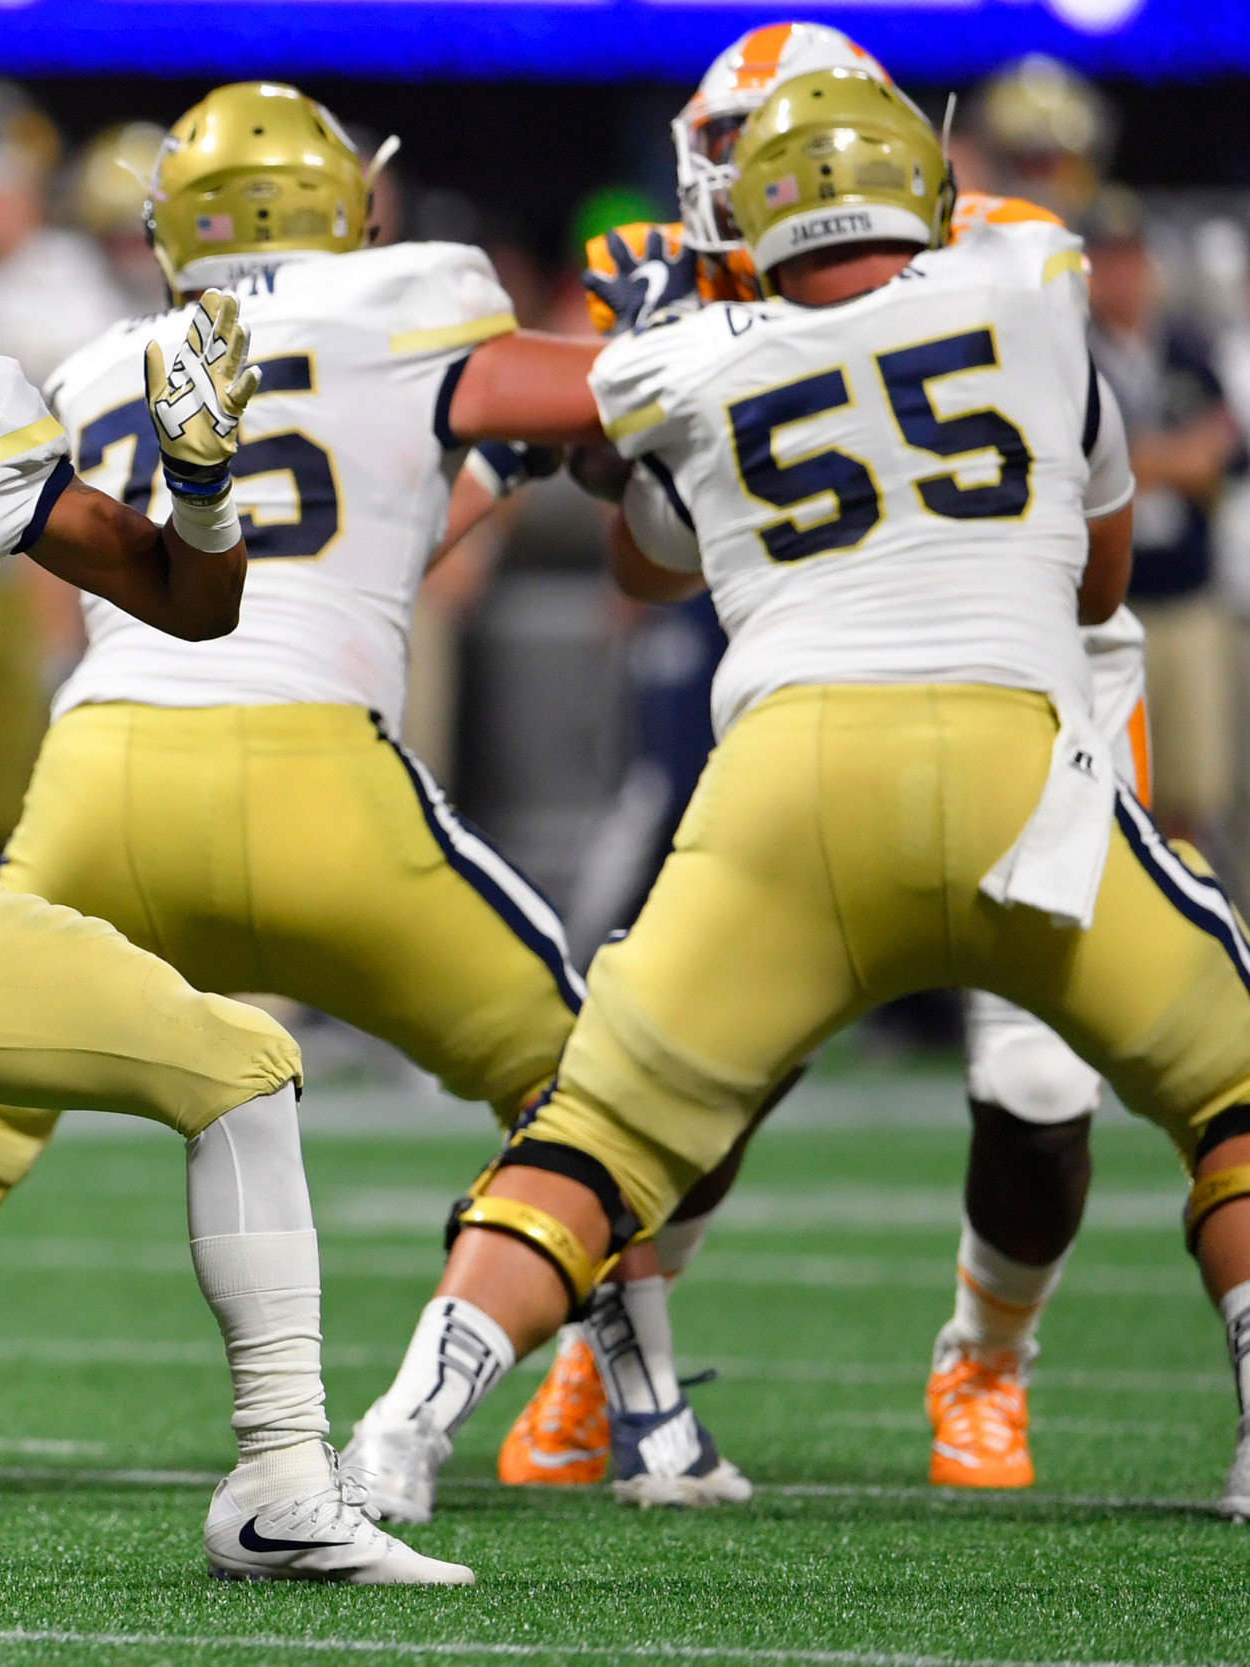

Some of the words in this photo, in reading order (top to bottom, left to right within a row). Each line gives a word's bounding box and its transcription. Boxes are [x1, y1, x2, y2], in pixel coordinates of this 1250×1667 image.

[790, 210, 873, 246] JACKETS
[75, 346, 347, 566] 75
[723, 322, 1037, 568] 55
